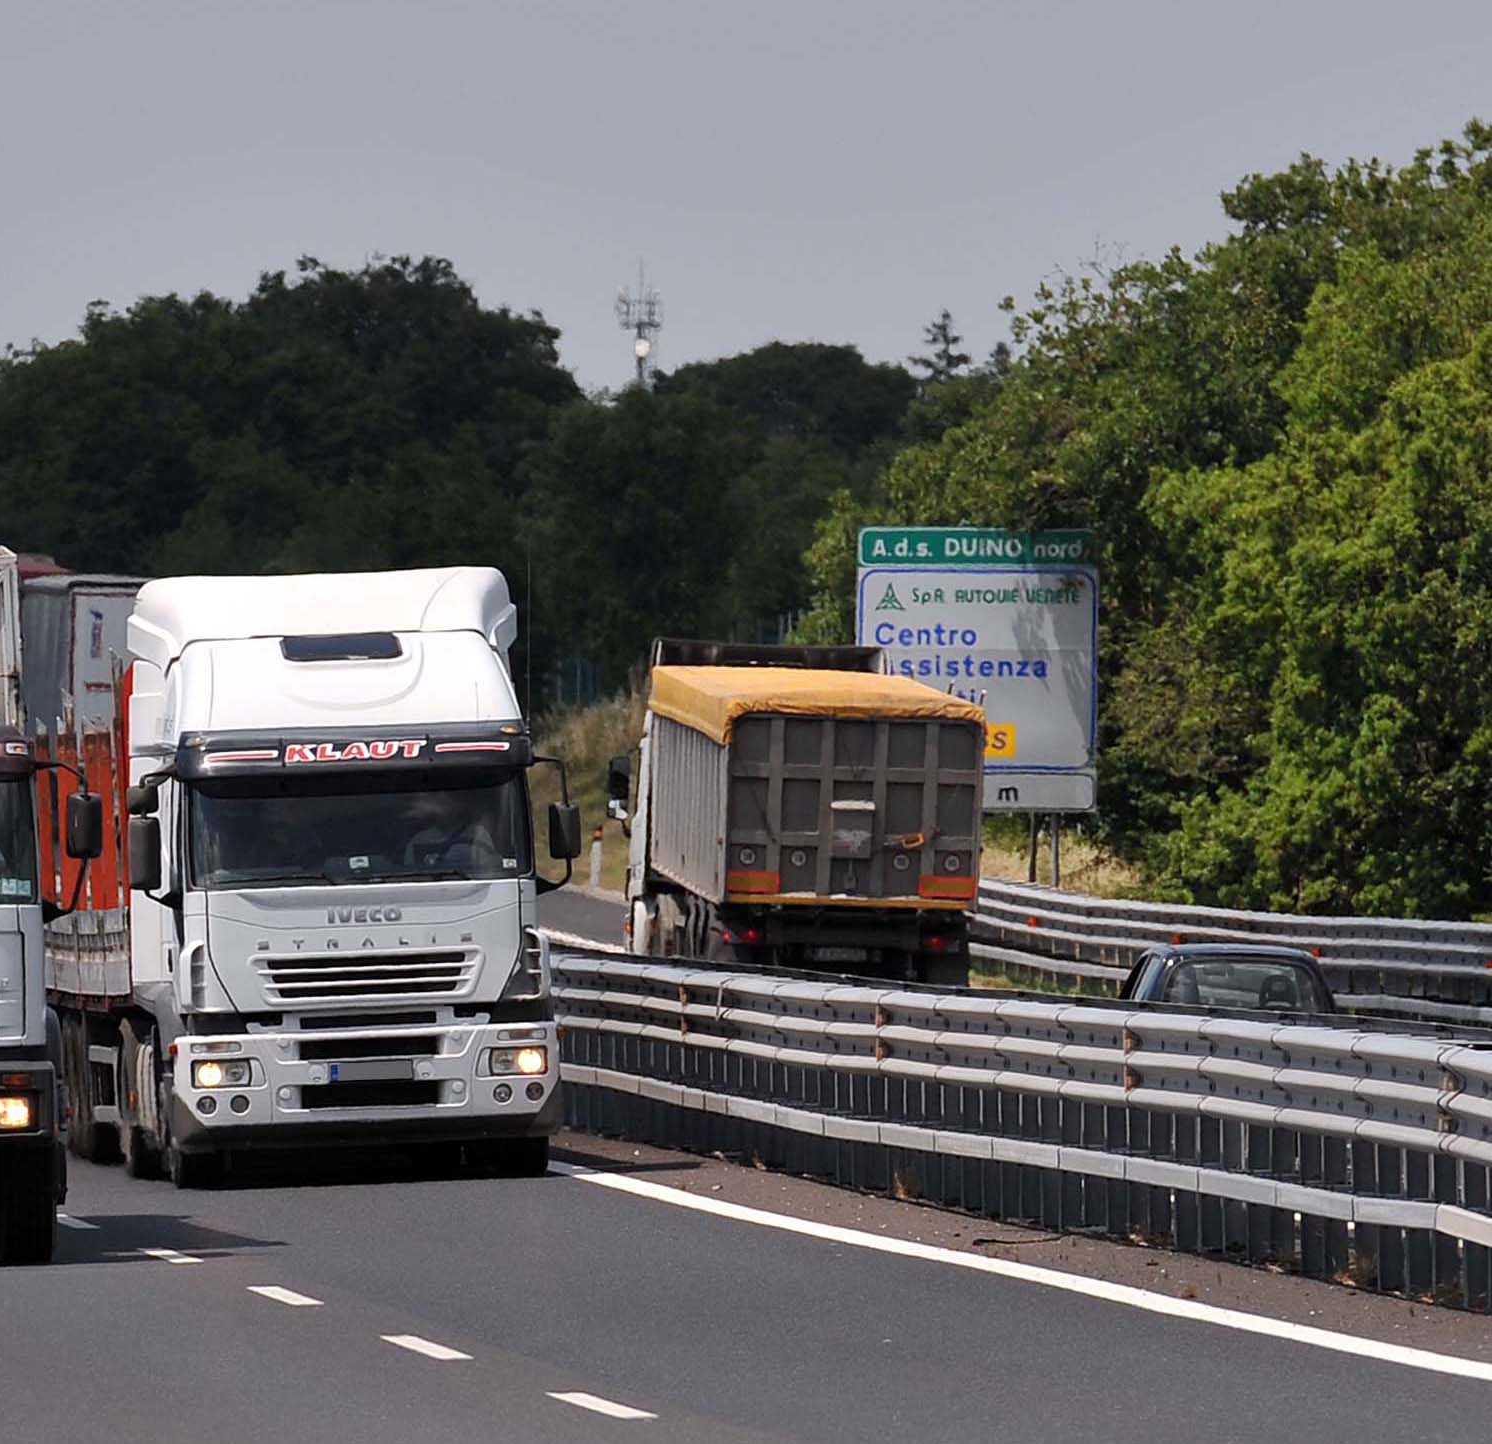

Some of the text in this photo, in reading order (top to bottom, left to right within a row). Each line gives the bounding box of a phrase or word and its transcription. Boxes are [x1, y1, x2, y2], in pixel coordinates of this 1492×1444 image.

[871, 538, 1085, 558] A.d.s. DUINO nord
[875, 622, 978, 646] Centro
[890, 654, 1048, 678] ssistenza
[284, 740, 427, 763] KLAUT
[326, 907, 403, 924] IVECO
[257, 932, 473, 951] STRALIS
